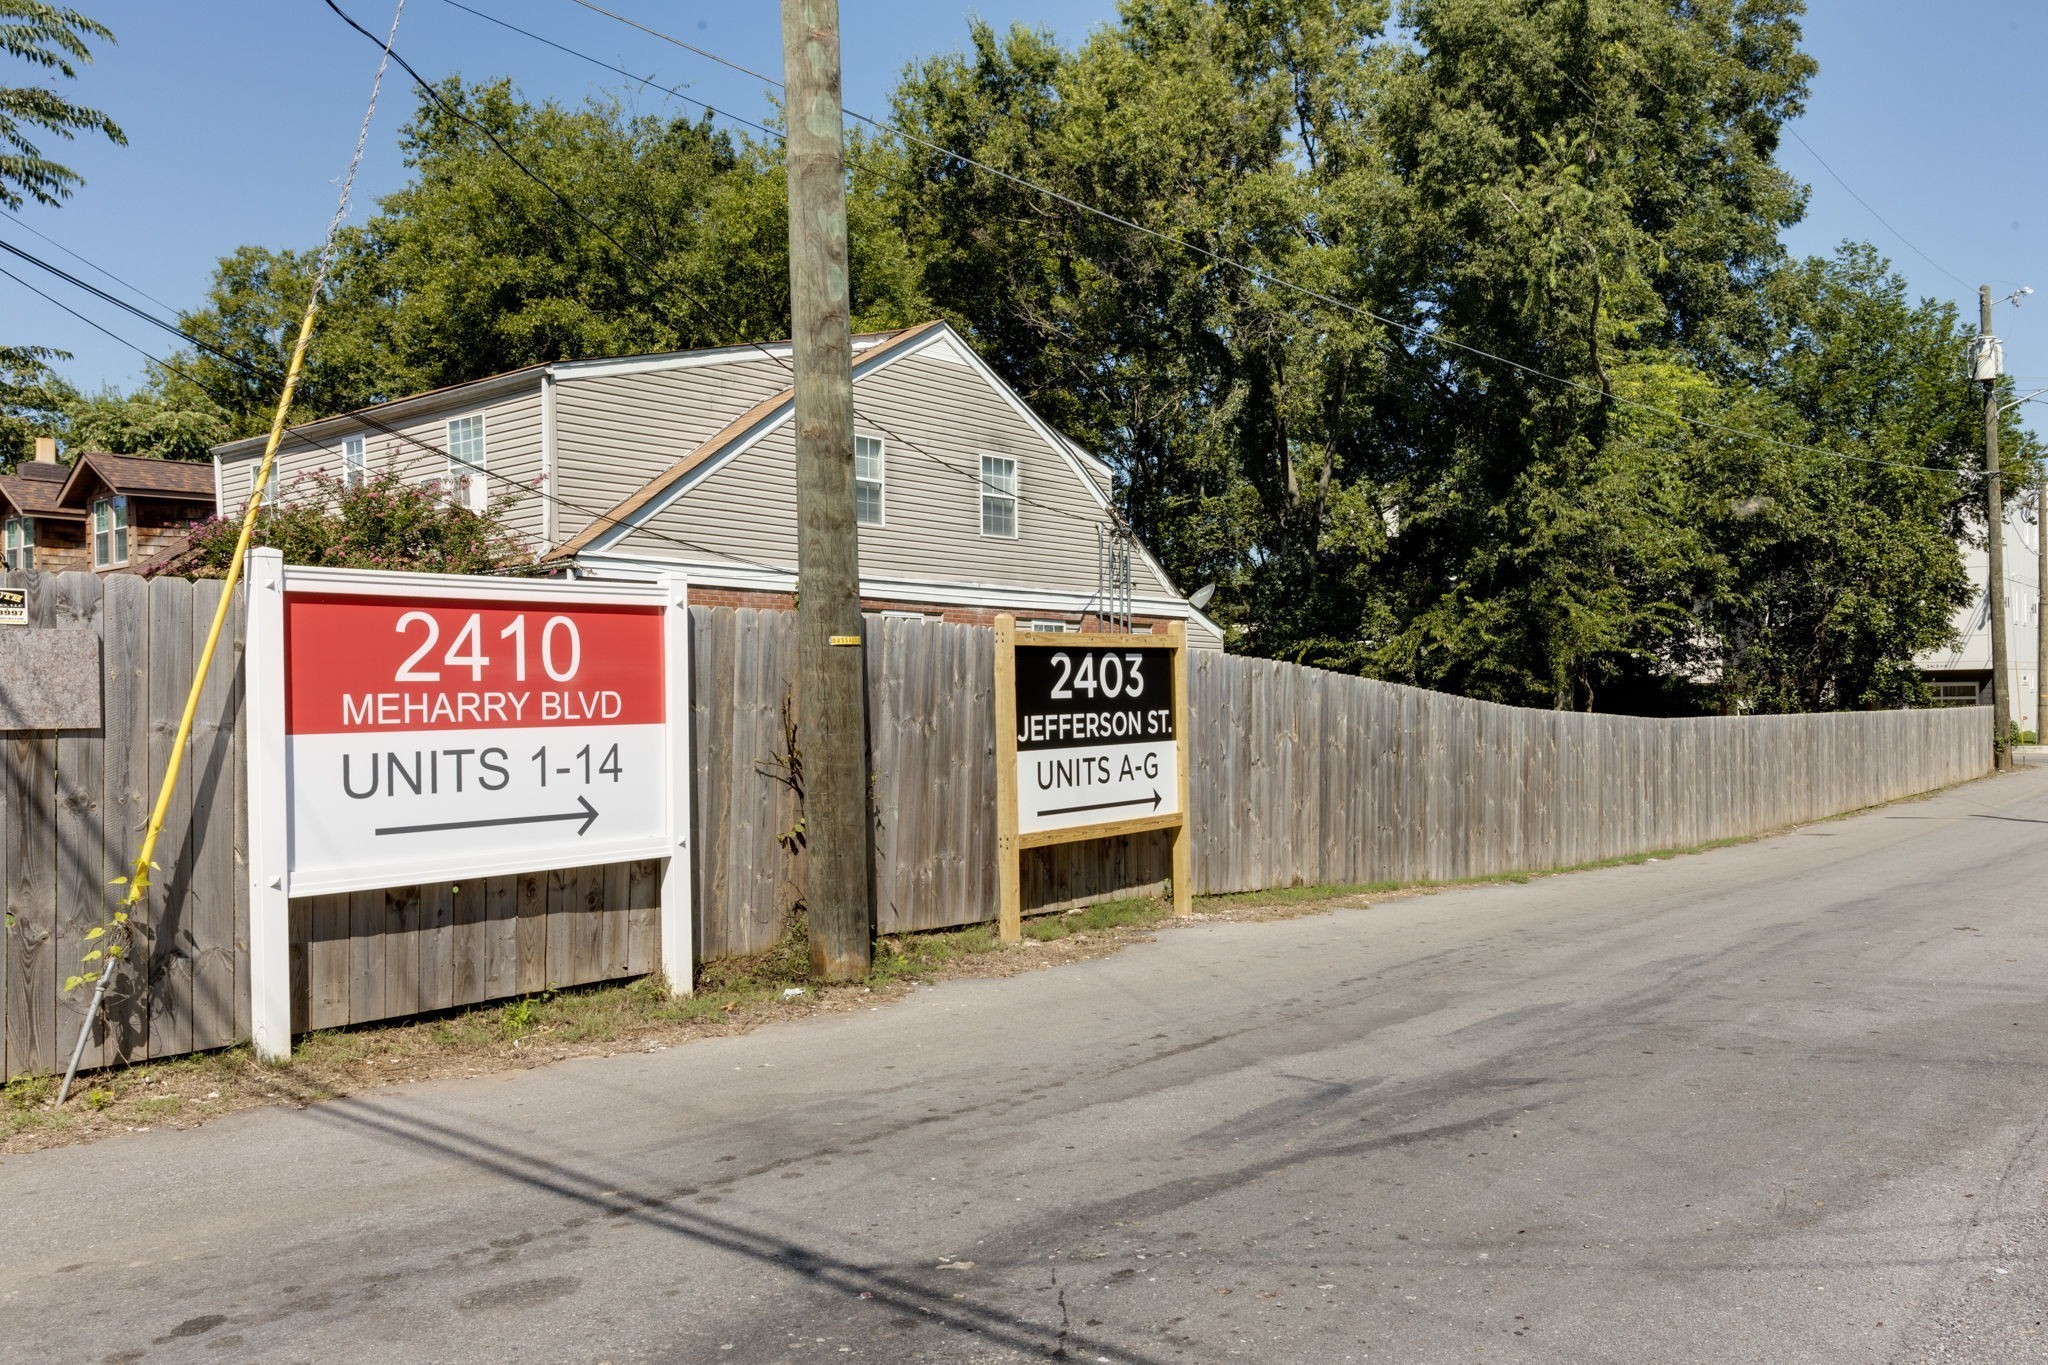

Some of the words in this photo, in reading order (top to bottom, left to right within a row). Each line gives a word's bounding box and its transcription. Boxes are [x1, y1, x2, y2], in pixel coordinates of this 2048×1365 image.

[394, 611, 581, 682] 2410
[1050, 652, 1144, 699] 2403
[342, 692, 530, 725] MEHARRY
[541, 691, 622, 720] BLVD
[1017, 711, 1142, 742] JEFFERSON
[1147, 710, 1172, 734] ST.
[342, 747, 510, 800] UNITS
[531, 743, 623, 787] 1-14
[1037, 756, 1110, 790] UNITS
[1118, 752, 1158, 783] A-G
